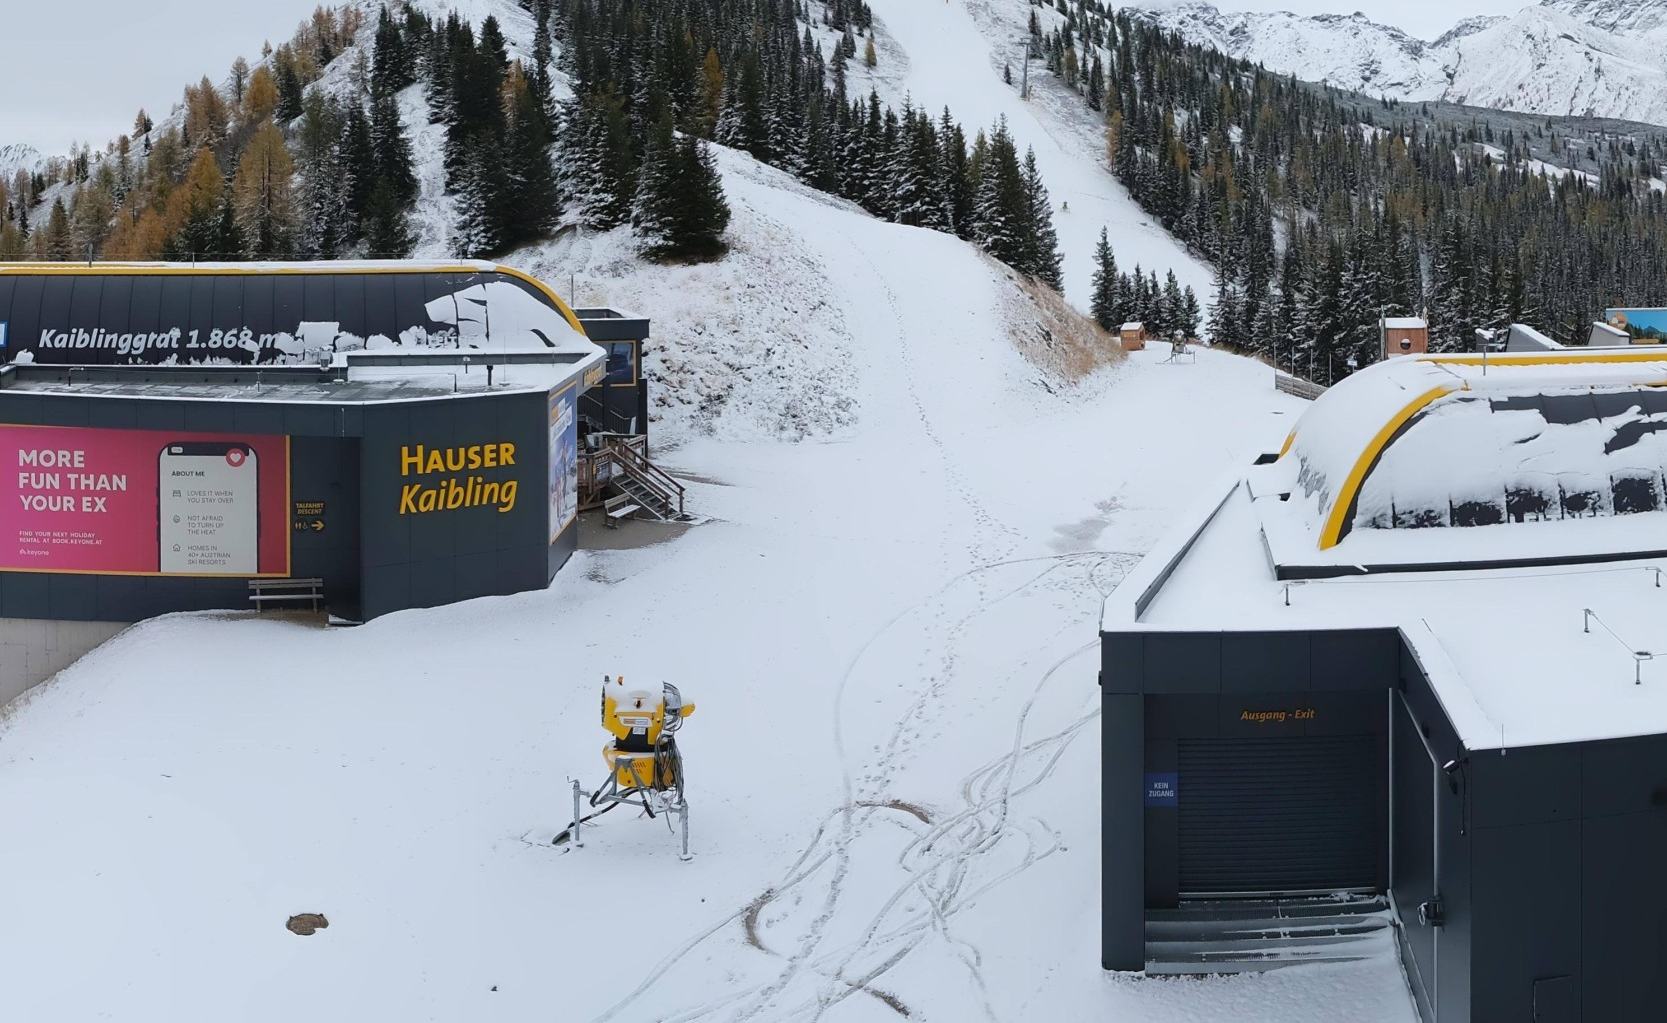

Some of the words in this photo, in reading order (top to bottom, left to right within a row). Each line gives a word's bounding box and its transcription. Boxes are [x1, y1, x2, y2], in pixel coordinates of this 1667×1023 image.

[38, 328, 181, 354] Kaiblinggrat
[186, 328, 252, 349] 1.868
[18, 449, 85, 468] MORE
[401, 443, 516, 476] HAUSER
[18, 472, 60, 489] FUN
[67, 474, 127, 491] THAN
[19, 495, 75, 512] YOUR
[82, 496, 107, 512] EX
[399, 477, 518, 514] Kaibling
[1240, 710, 1286, 722] Ausgang
[1294, 708, 1315, 719] Exit
